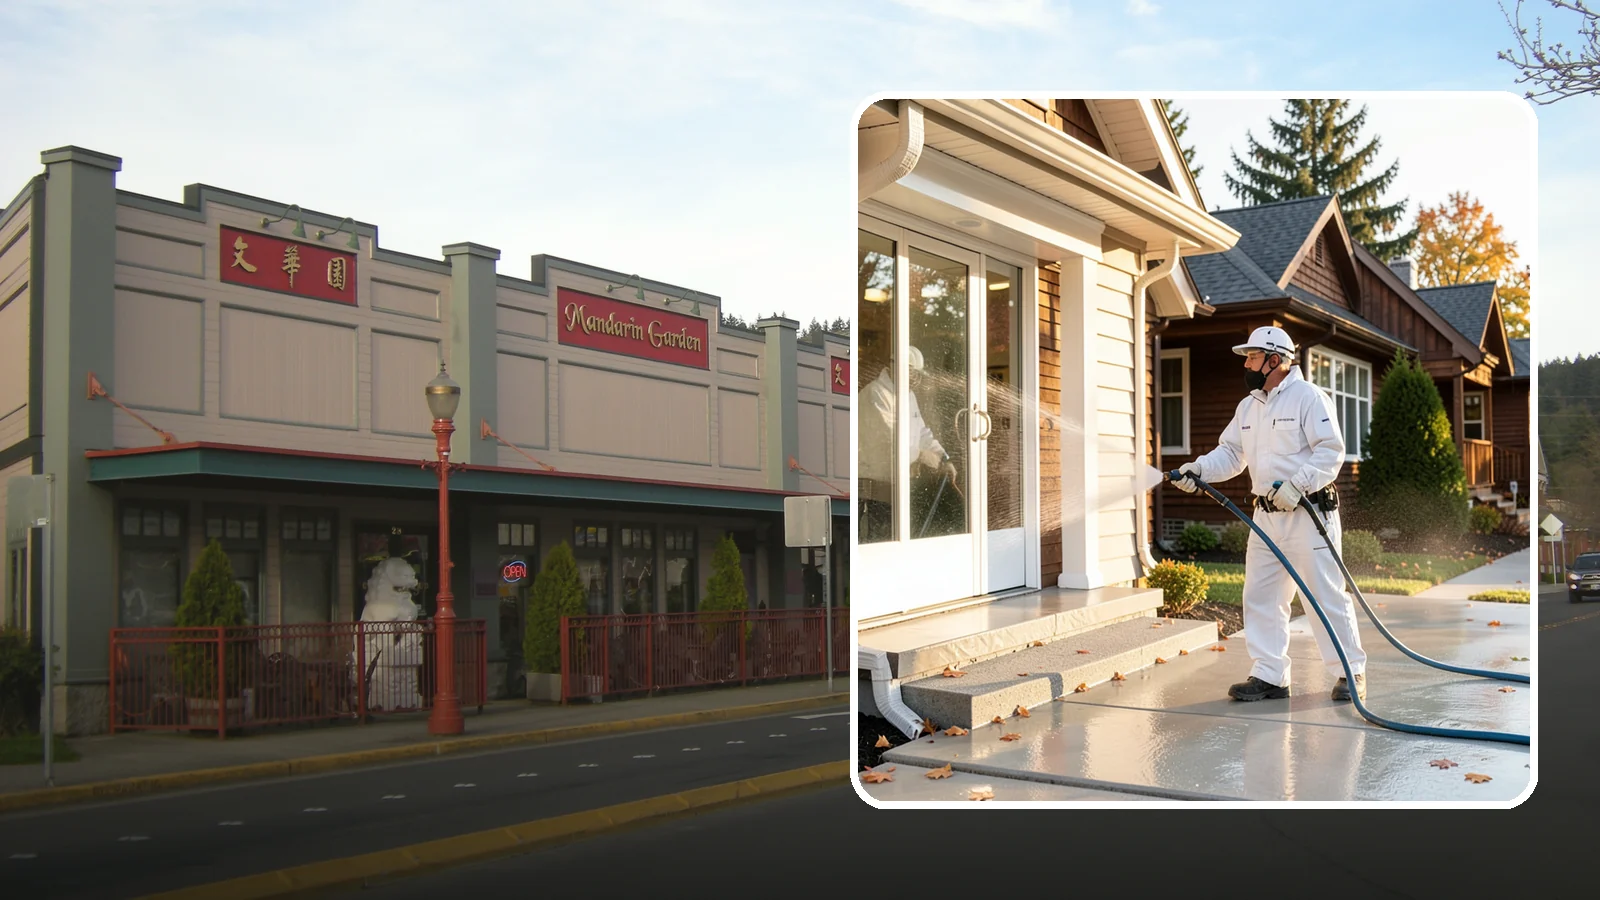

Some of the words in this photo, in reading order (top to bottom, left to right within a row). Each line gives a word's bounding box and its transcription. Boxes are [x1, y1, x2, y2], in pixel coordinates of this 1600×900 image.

[230, 235, 346, 291] 文華園
[564, 302, 644, 341] Mandarin
[647, 320, 702, 352] Garden
[503, 565, 527, 578] OPEN
